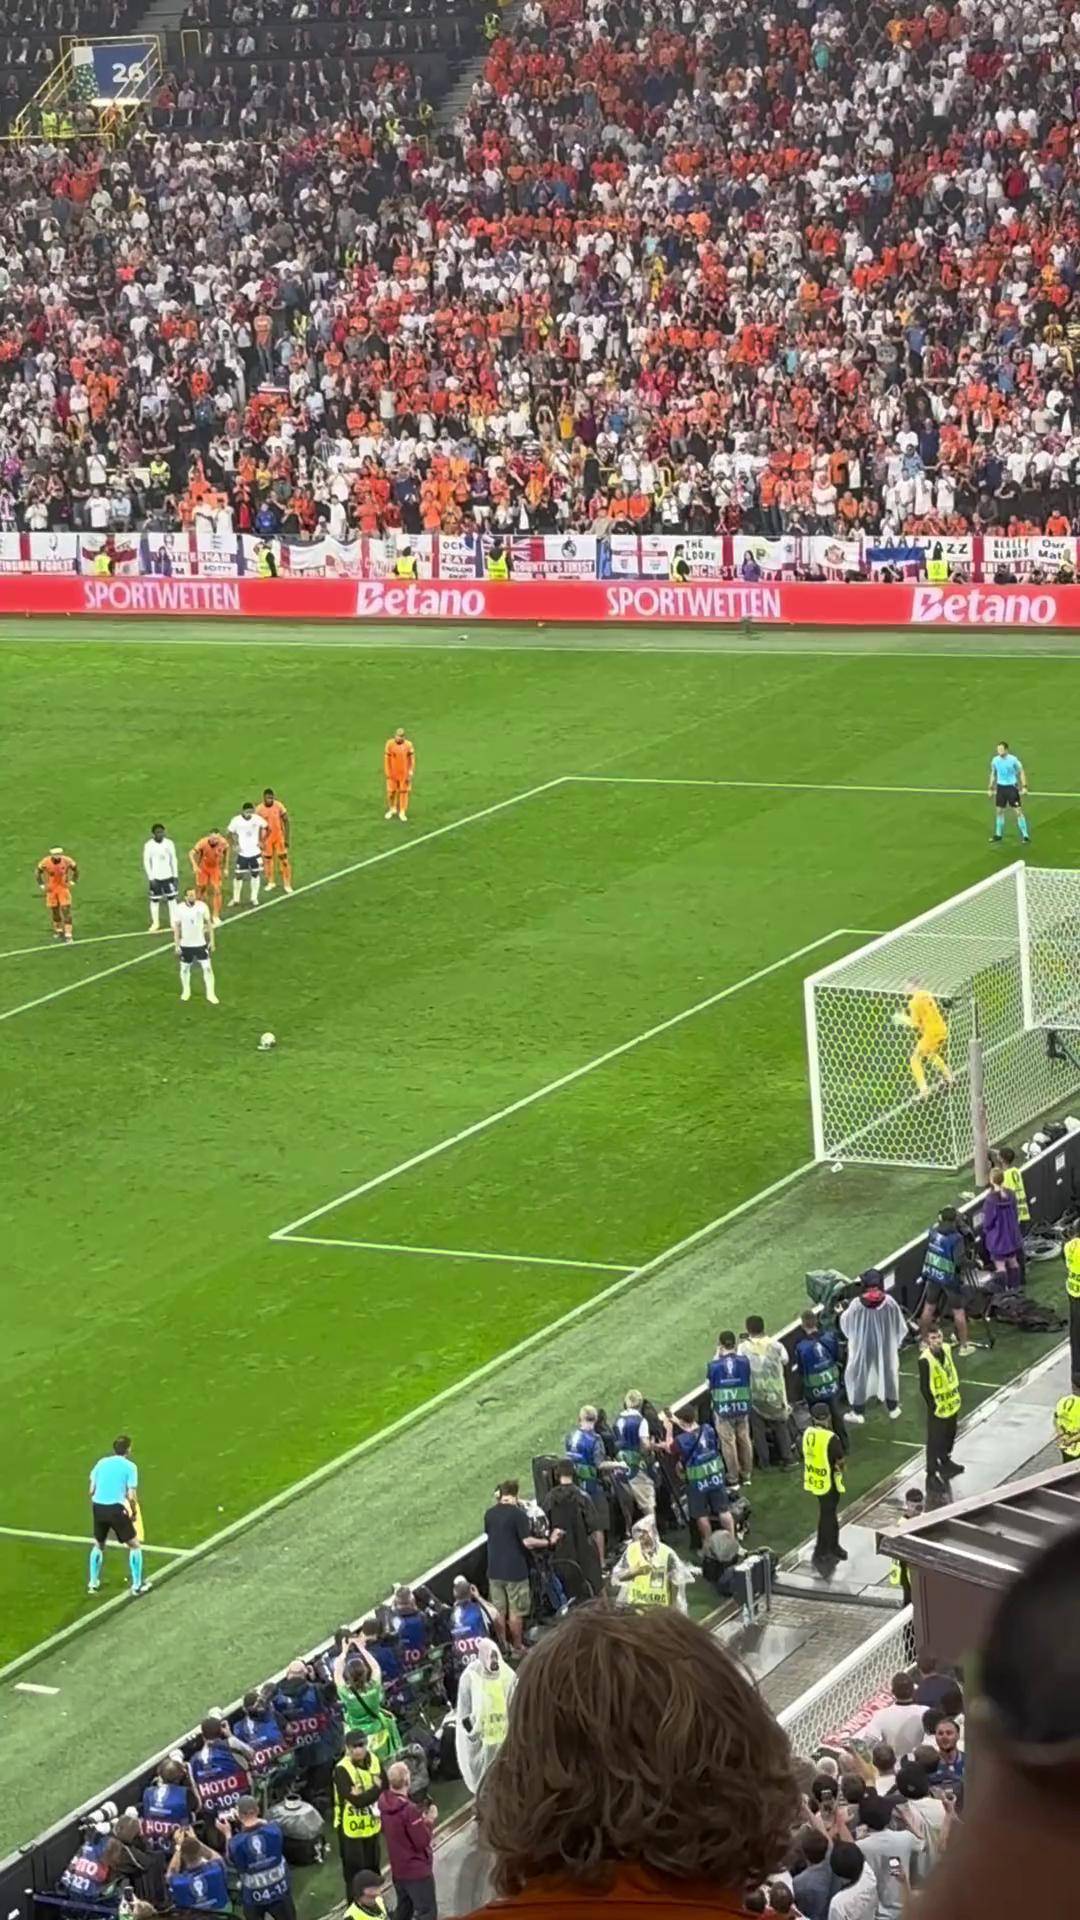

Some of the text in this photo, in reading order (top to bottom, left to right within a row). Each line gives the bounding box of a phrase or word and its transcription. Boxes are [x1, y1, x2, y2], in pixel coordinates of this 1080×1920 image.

[112, 62, 145, 83] 26
[84, 582, 240, 610] SPORTWETTEN
[356, 581, 486, 617] Betano
[606, 586, 782, 618] SPORTWETTEN
[910, 586, 1057, 623] Betano
[720, 1389, 738, 1401] TV
[702, 1460, 719, 1476] TV
